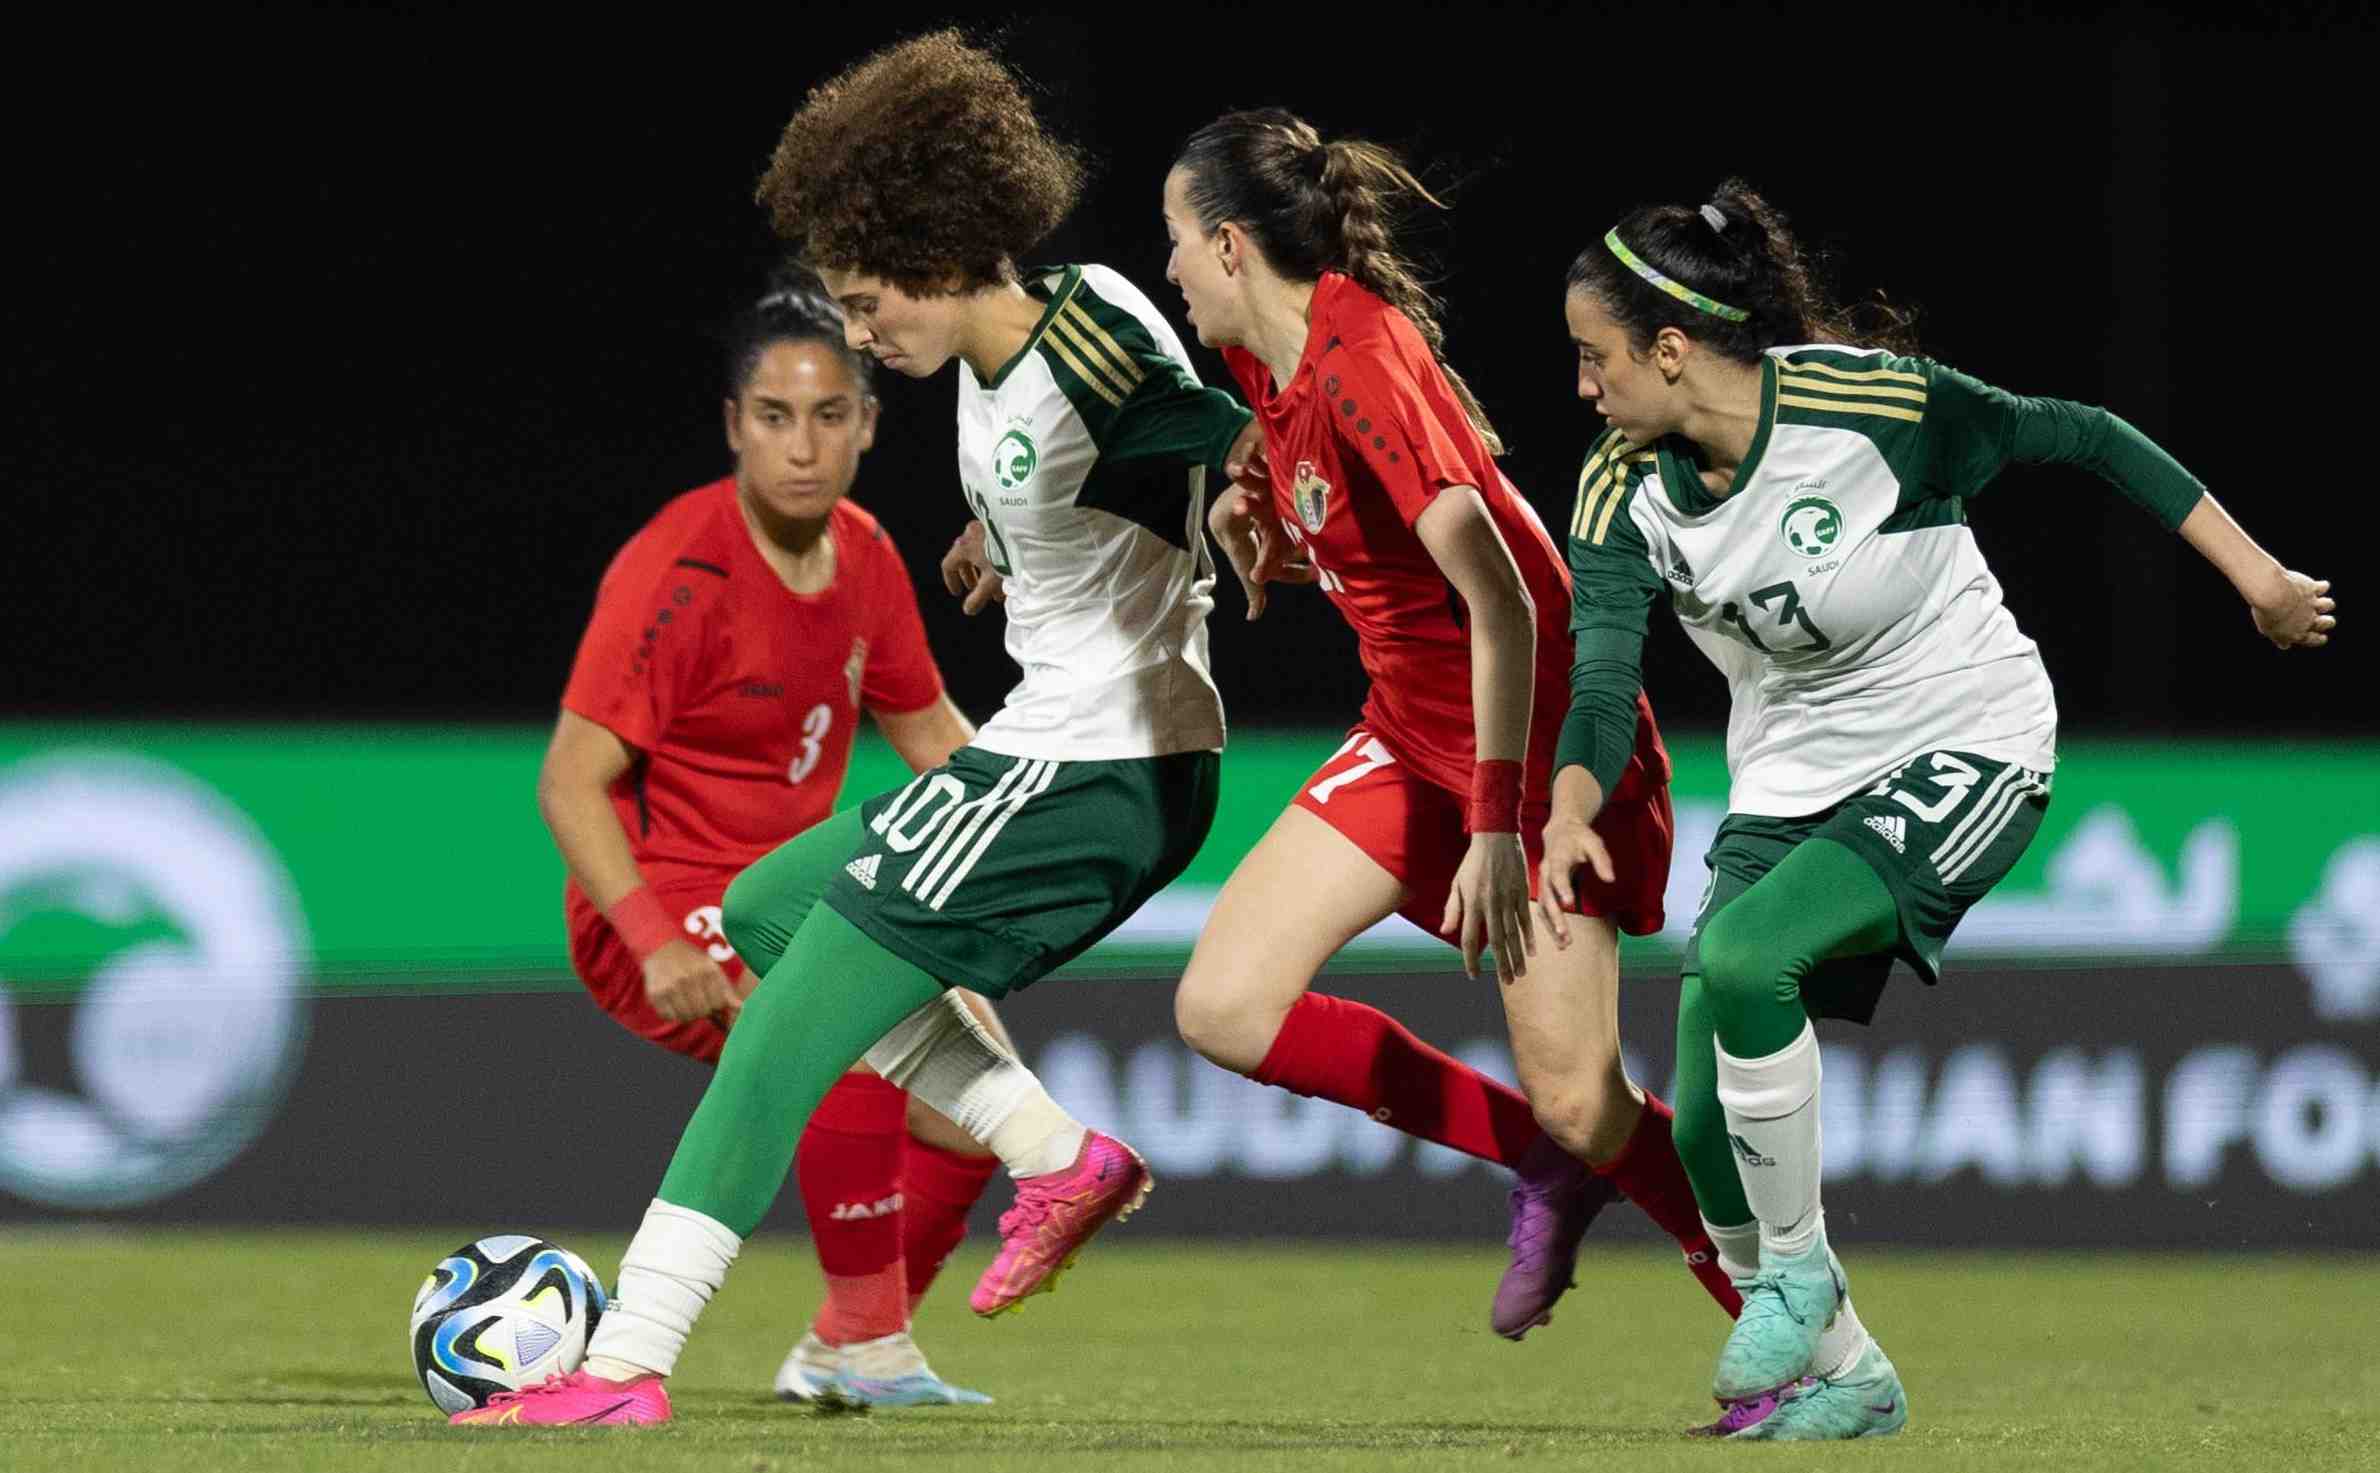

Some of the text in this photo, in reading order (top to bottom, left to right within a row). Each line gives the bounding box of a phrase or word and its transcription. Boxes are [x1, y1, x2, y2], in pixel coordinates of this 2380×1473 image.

[1000, 497, 1028, 506] SAUDI
[1808, 560, 1840, 577] SAUDI
[788, 704, 831, 784] 3
[870, 773, 965, 853] 10
[1863, 817, 1906, 854] adidas
[684, 906, 736, 961] 3
[2160, 1042, 2380, 1190] FO
